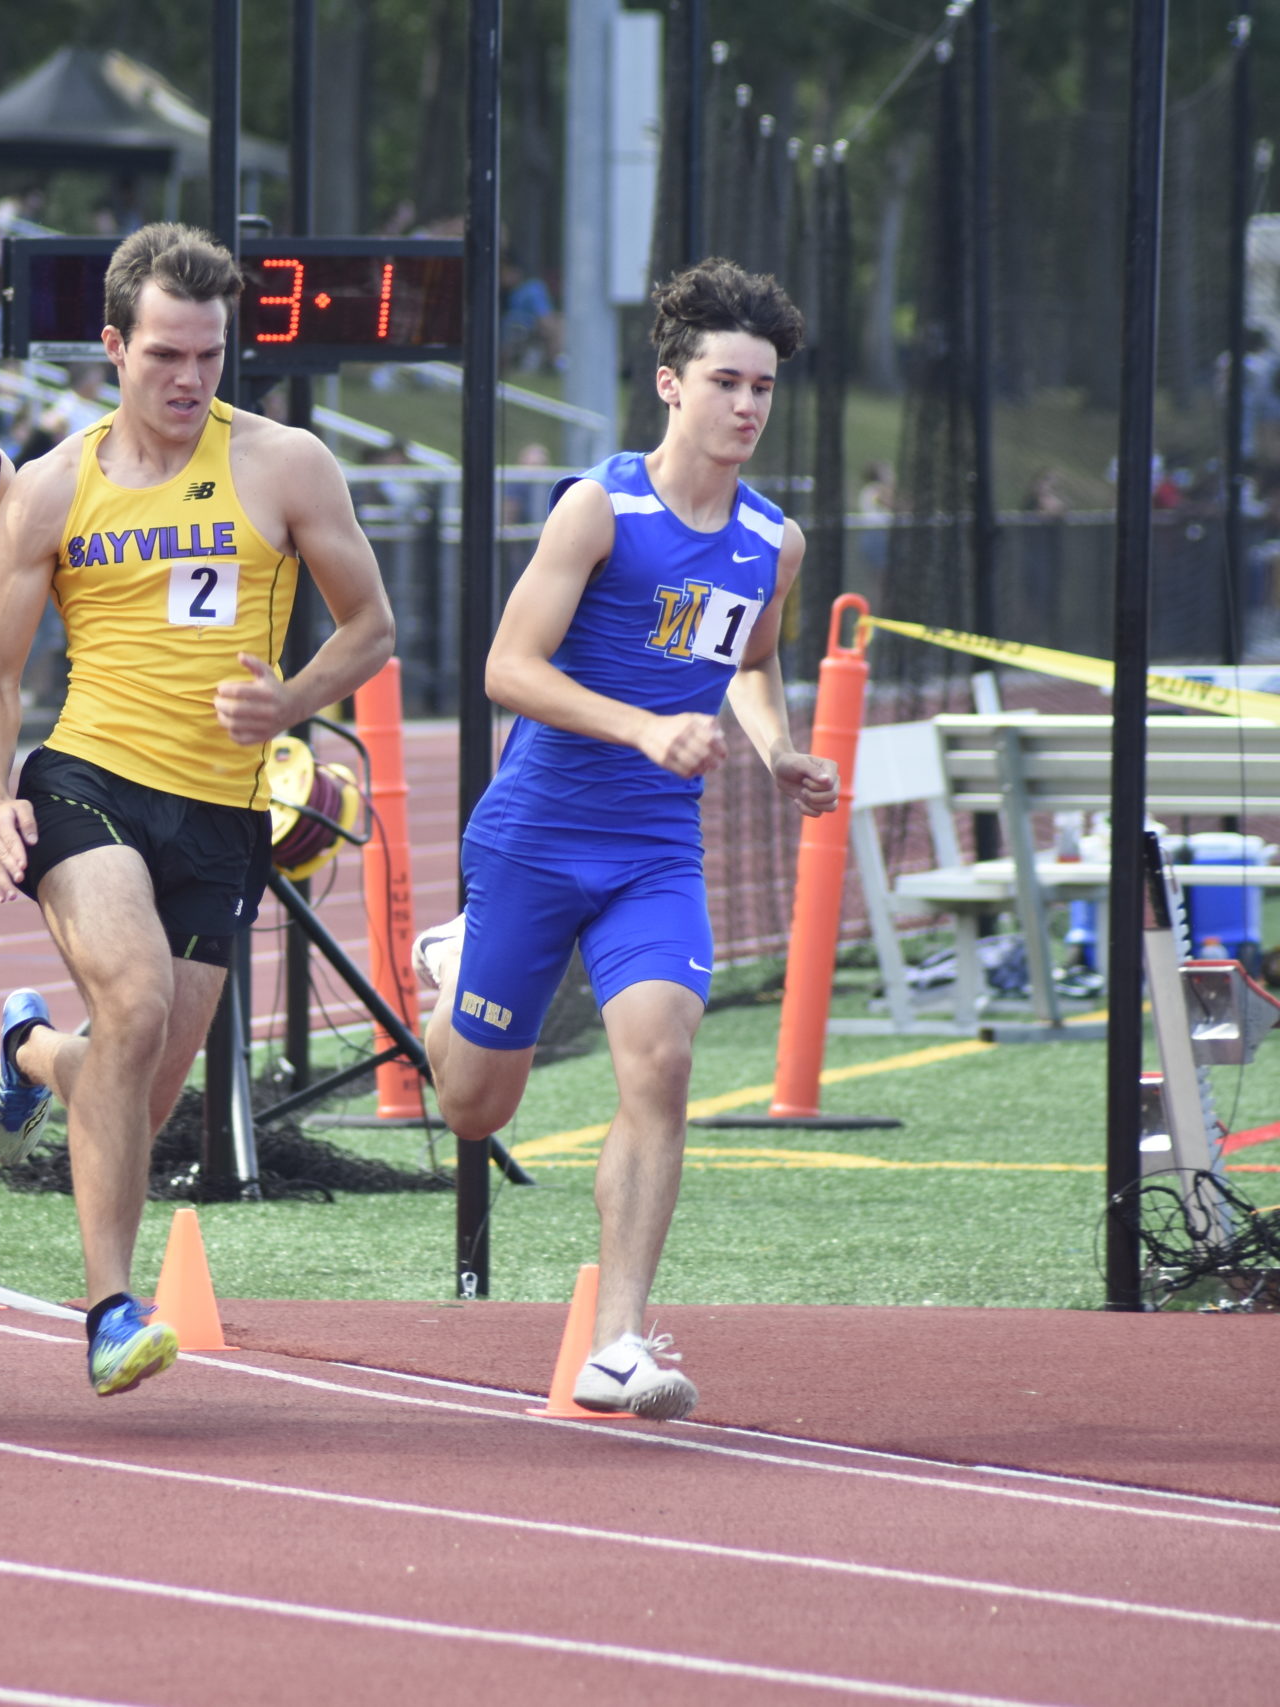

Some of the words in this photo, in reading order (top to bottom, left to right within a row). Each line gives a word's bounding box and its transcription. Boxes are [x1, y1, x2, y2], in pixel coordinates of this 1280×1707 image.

[67, 521, 238, 568] SAYVILLE
[189, 567, 219, 618] 2
[713, 603, 747, 657] 1
